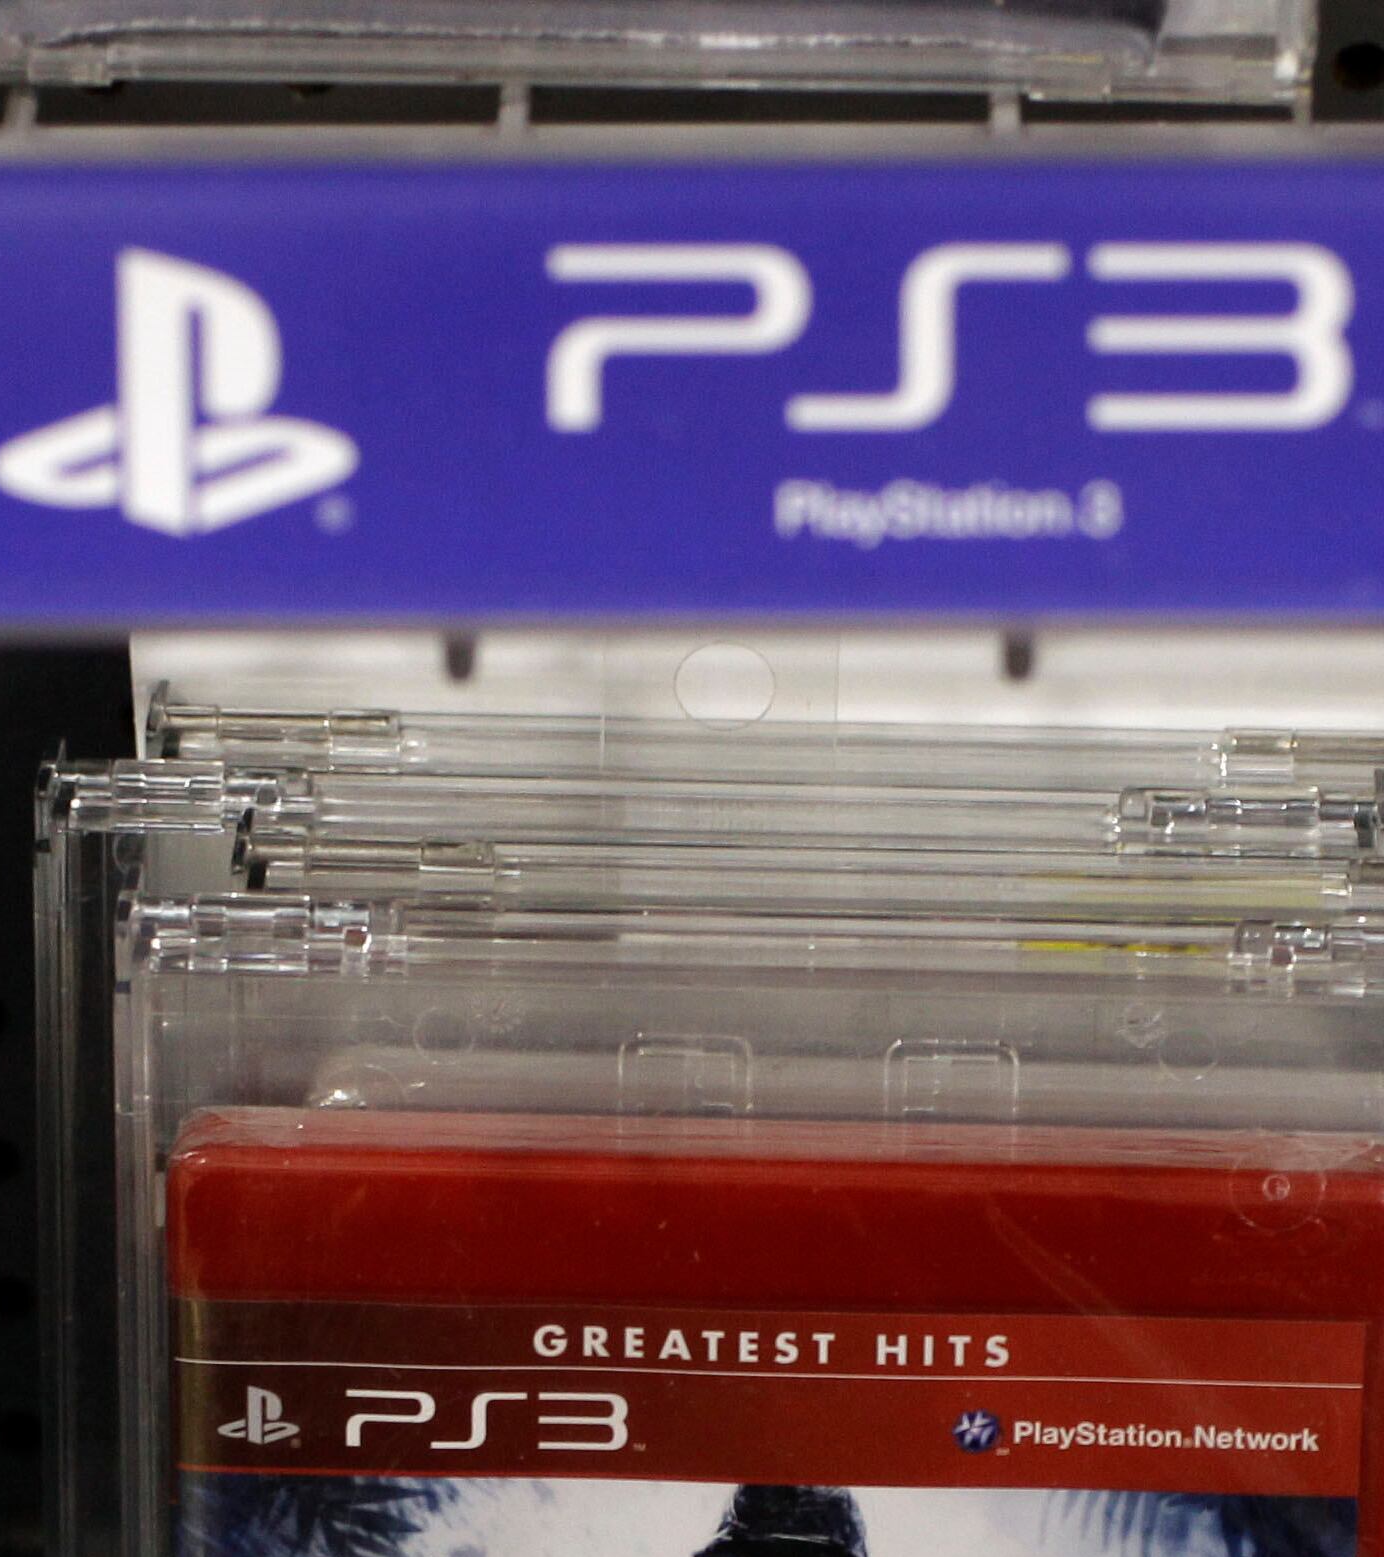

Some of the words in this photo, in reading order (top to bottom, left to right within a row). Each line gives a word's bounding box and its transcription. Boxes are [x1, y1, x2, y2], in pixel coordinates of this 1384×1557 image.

[545, 242, 1354, 434] PS3
[533, 1325, 835, 1365] GREATEST
[876, 1333, 1010, 1368] HITS
[345, 1389, 628, 1451] PS3
